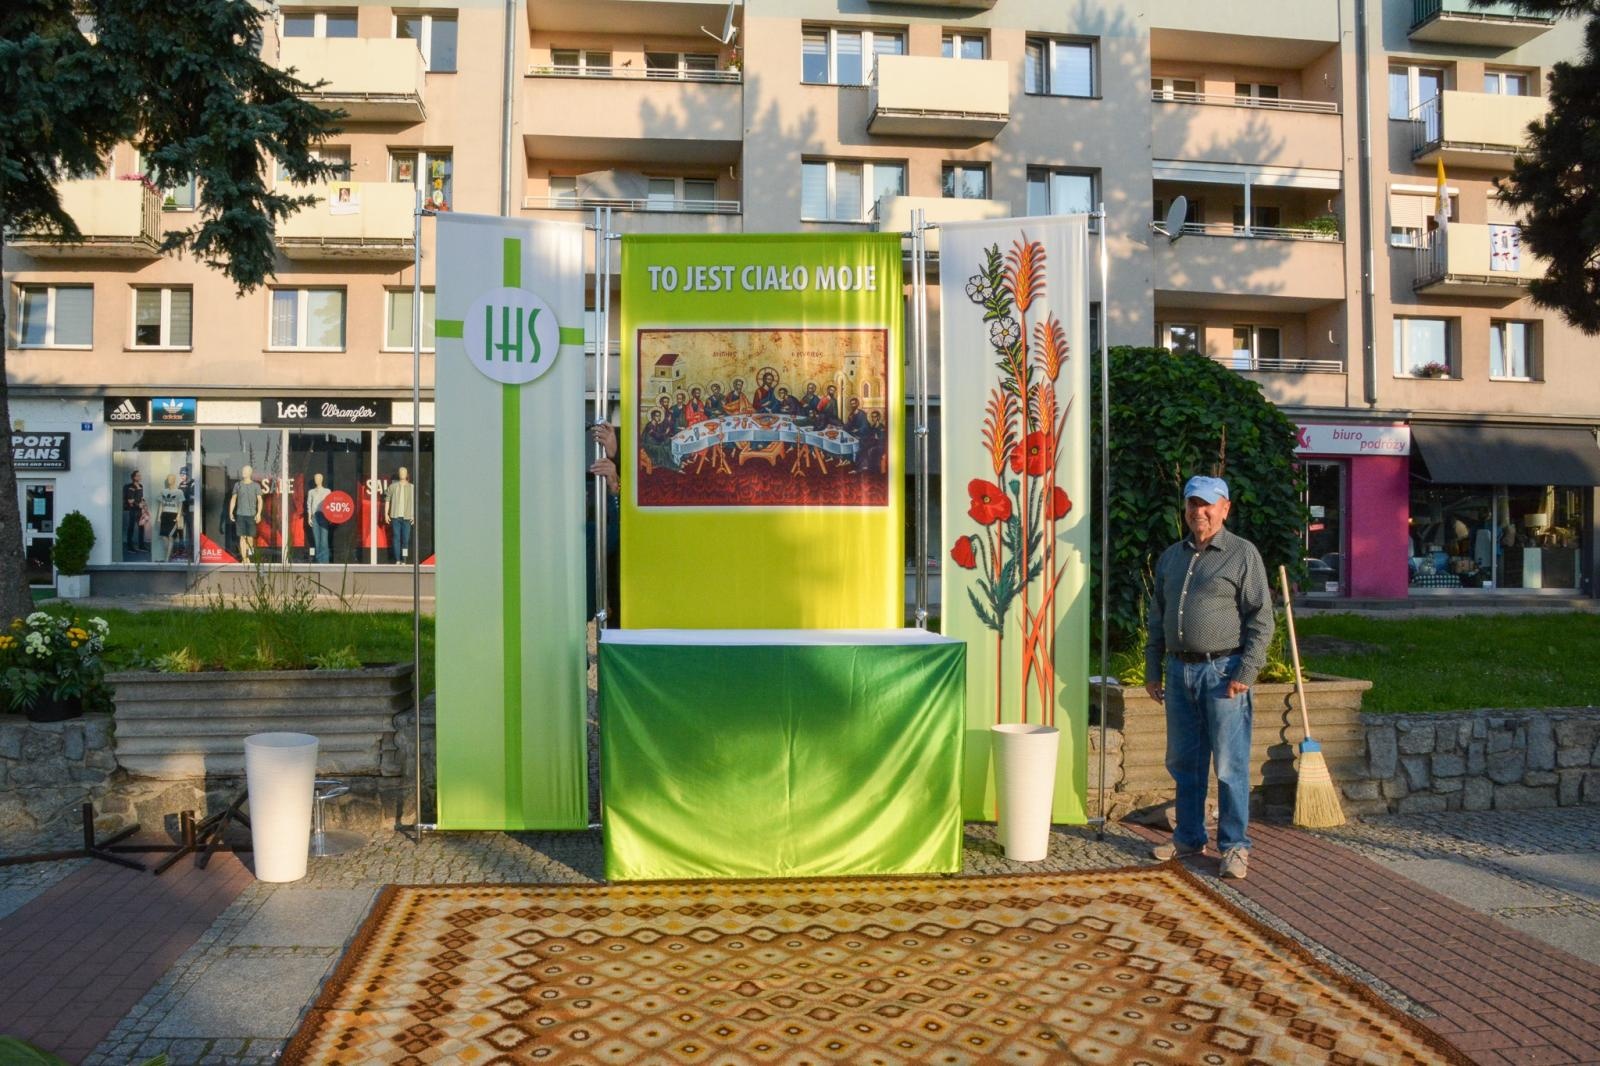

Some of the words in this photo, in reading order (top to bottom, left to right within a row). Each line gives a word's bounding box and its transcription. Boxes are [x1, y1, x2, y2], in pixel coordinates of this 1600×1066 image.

[648, 266, 678, 291] TO
[683, 266, 735, 291] JEST
[741, 265, 808, 291] CIAŁO
[815, 265, 877, 291] MOJE
[485, 305, 542, 363] IHS
[277, 401, 308, 418] Lee
[321, 402, 376, 422] Wrangler
[11, 436, 65, 447] PORT
[1333, 429, 1363, 440] biuro
[12, 448, 60, 460] EANS
[366, 479, 388, 495] SAL
[325, 502, 351, 513] -50%
[201, 548, 222, 556] SALE
